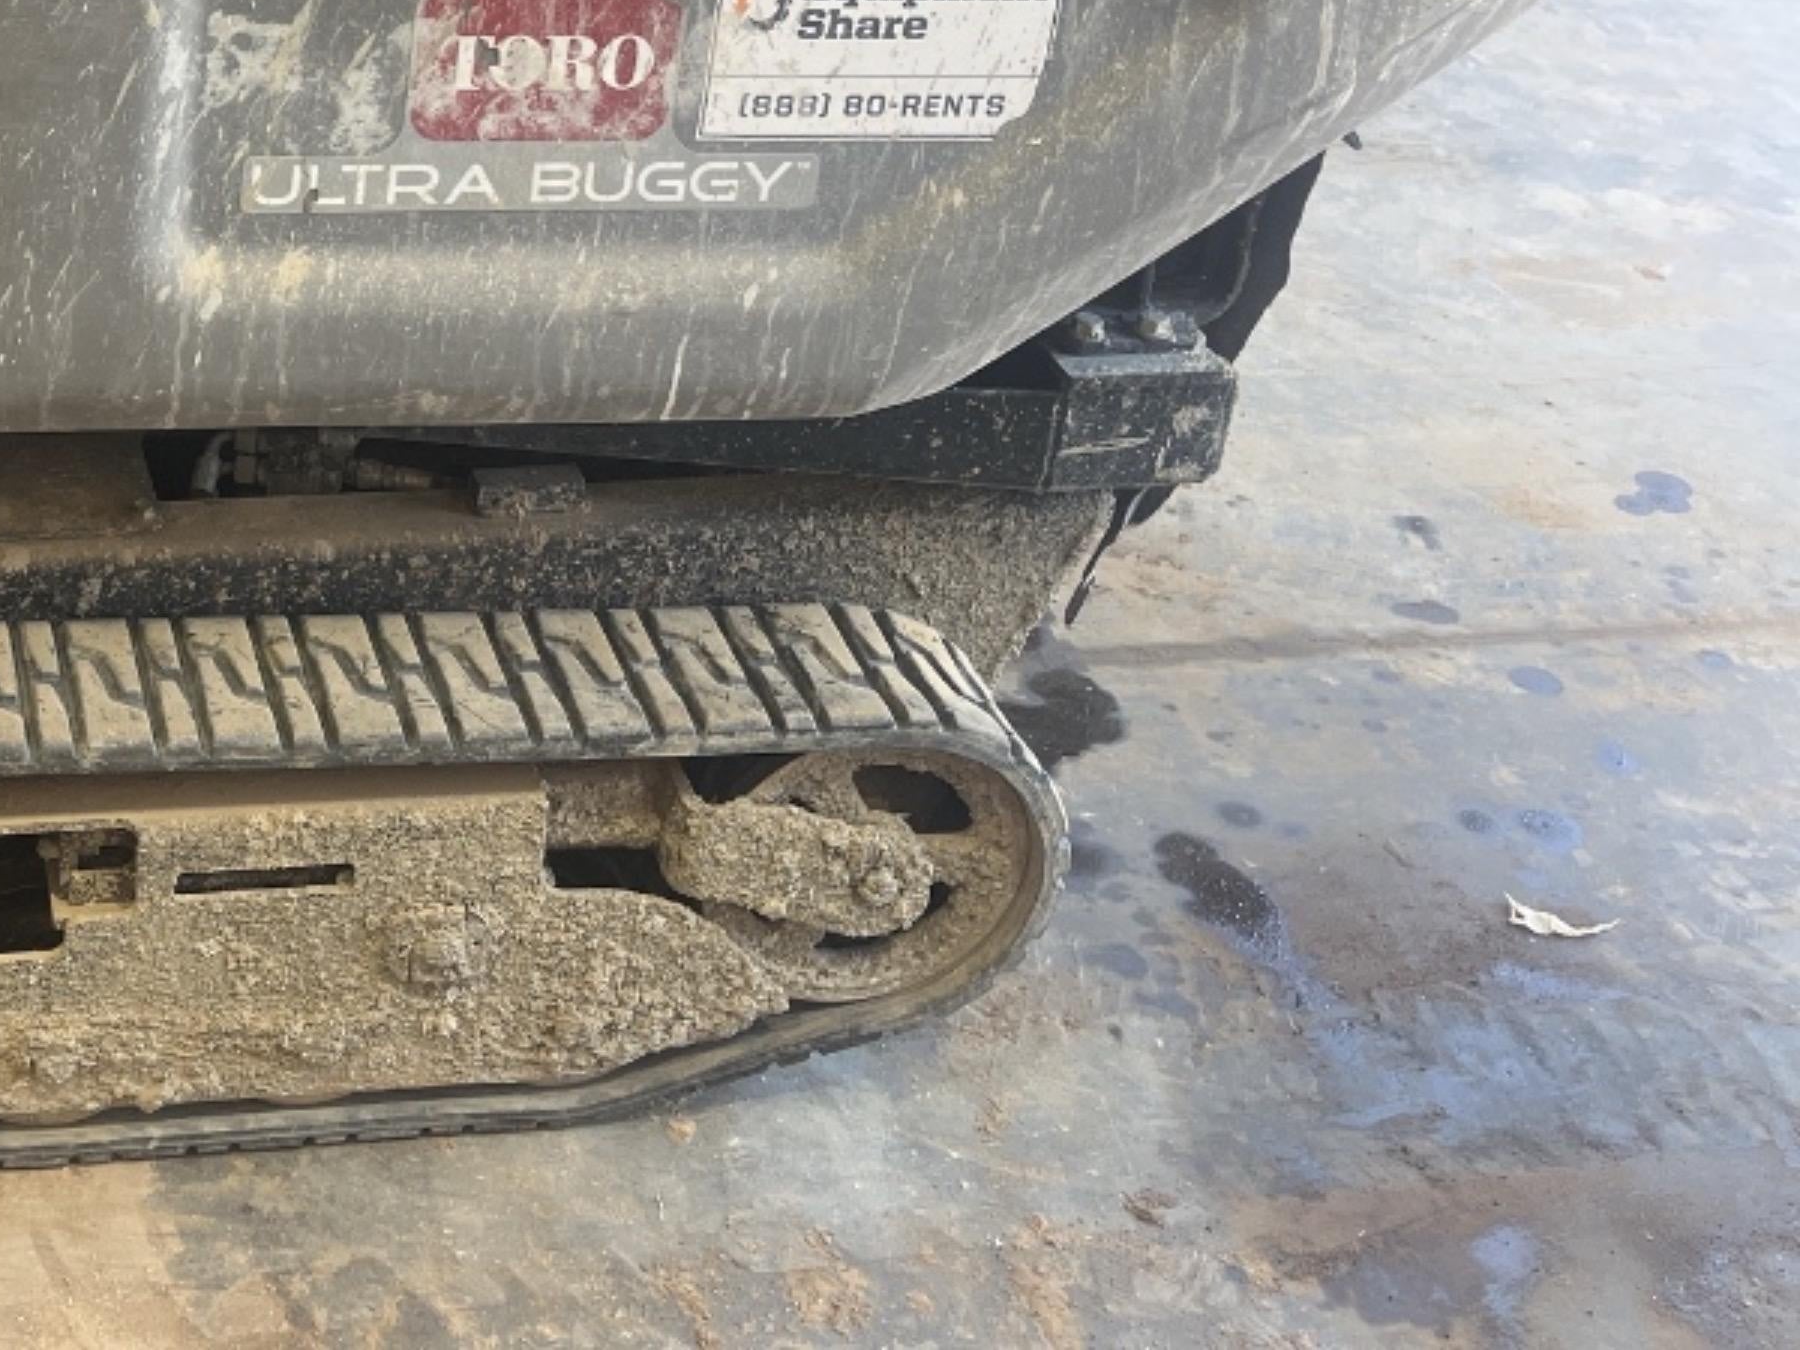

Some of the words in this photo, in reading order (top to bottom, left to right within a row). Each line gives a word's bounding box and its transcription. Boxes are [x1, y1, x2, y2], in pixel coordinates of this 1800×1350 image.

[797, 8, 929, 40] Share
[447, 32, 656, 91] TORO
[738, 93, 833, 118] (888)
[842, 94, 1007, 118] 80-RENTS
[250, 161, 501, 205] ULTRA
